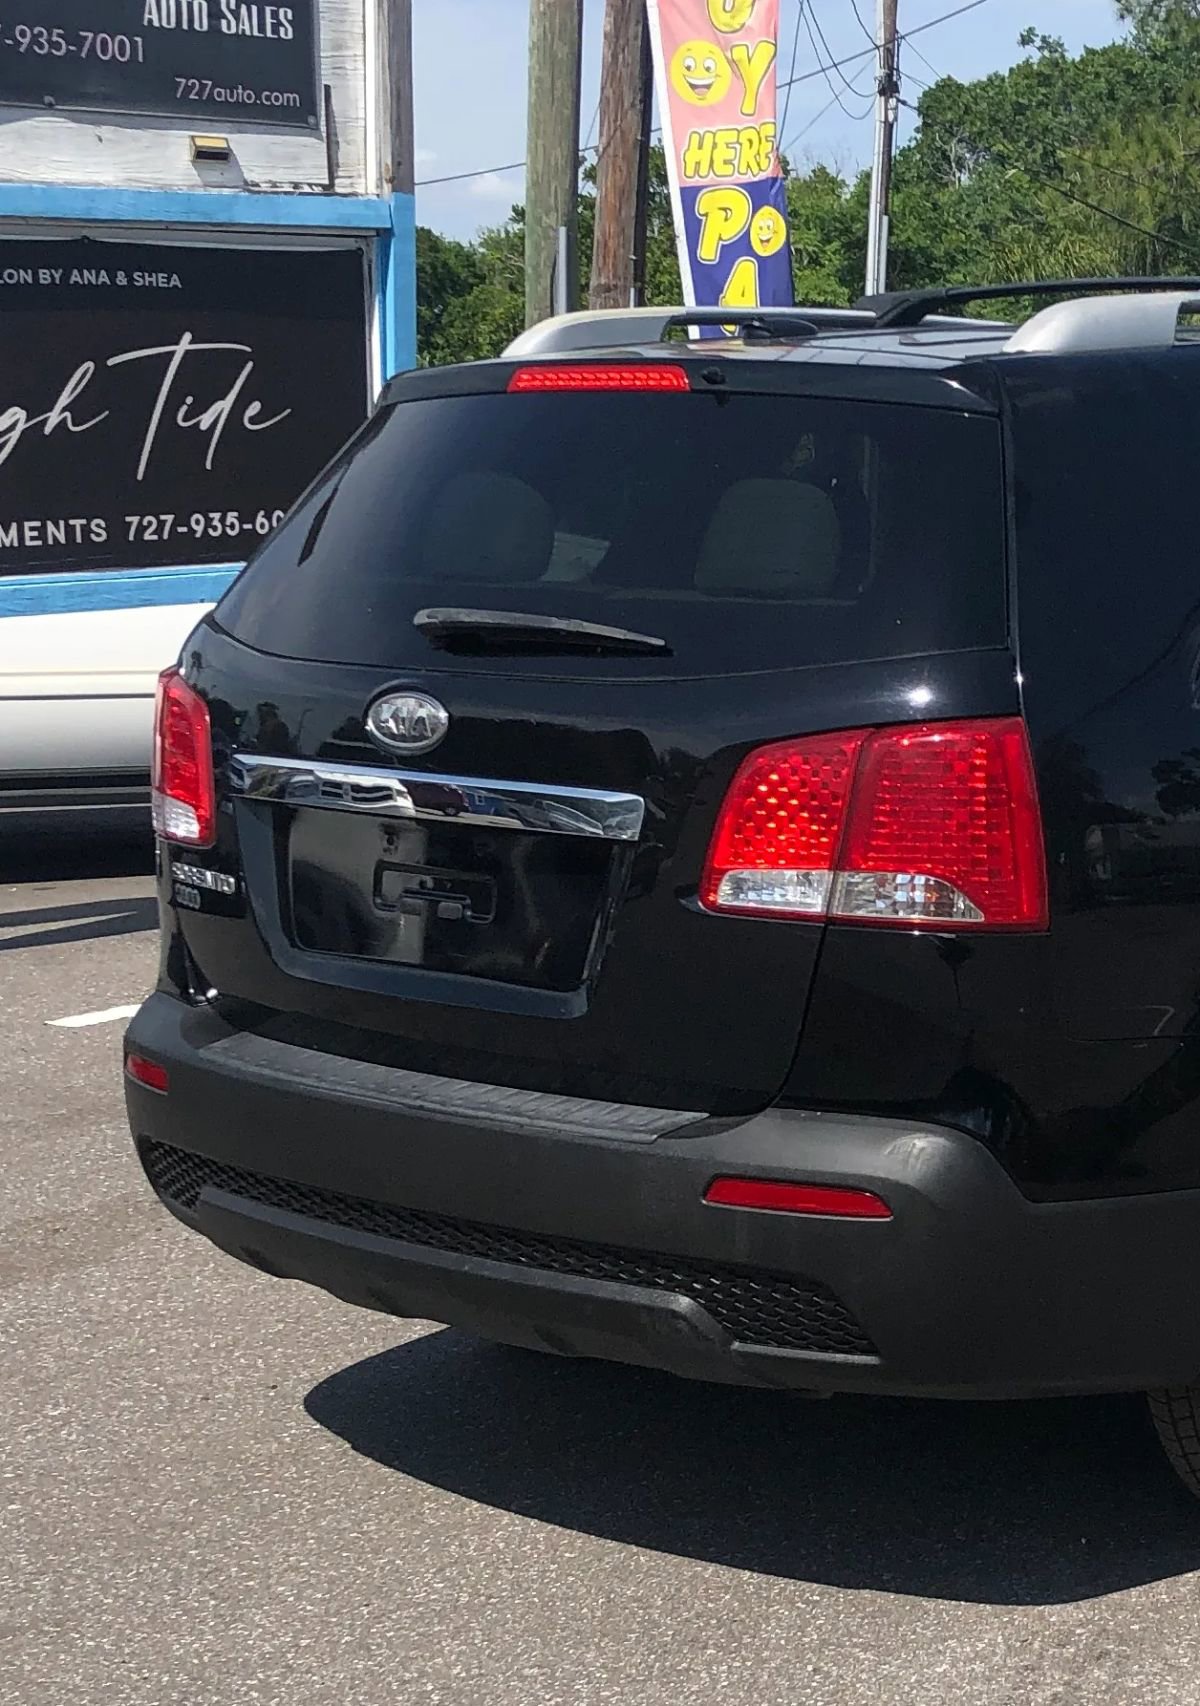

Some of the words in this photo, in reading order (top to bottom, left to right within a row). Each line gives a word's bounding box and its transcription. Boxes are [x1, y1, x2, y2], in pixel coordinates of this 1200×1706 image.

[143, 0, 209, 32] AUTO
[220, 0, 294, 40] SALES
[0, 24, 144, 63] -935-7001
[174, 77, 301, 107] 727auto.com
[684, 121, 777, 179] HERE
[0, 268, 33, 285] ON
[38, 268, 63, 285] BY
[69, 268, 111, 286] ANA
[115, 270, 128, 286] &
[133, 271, 182, 289] SHEA
[106, 331, 291, 481] Tide
